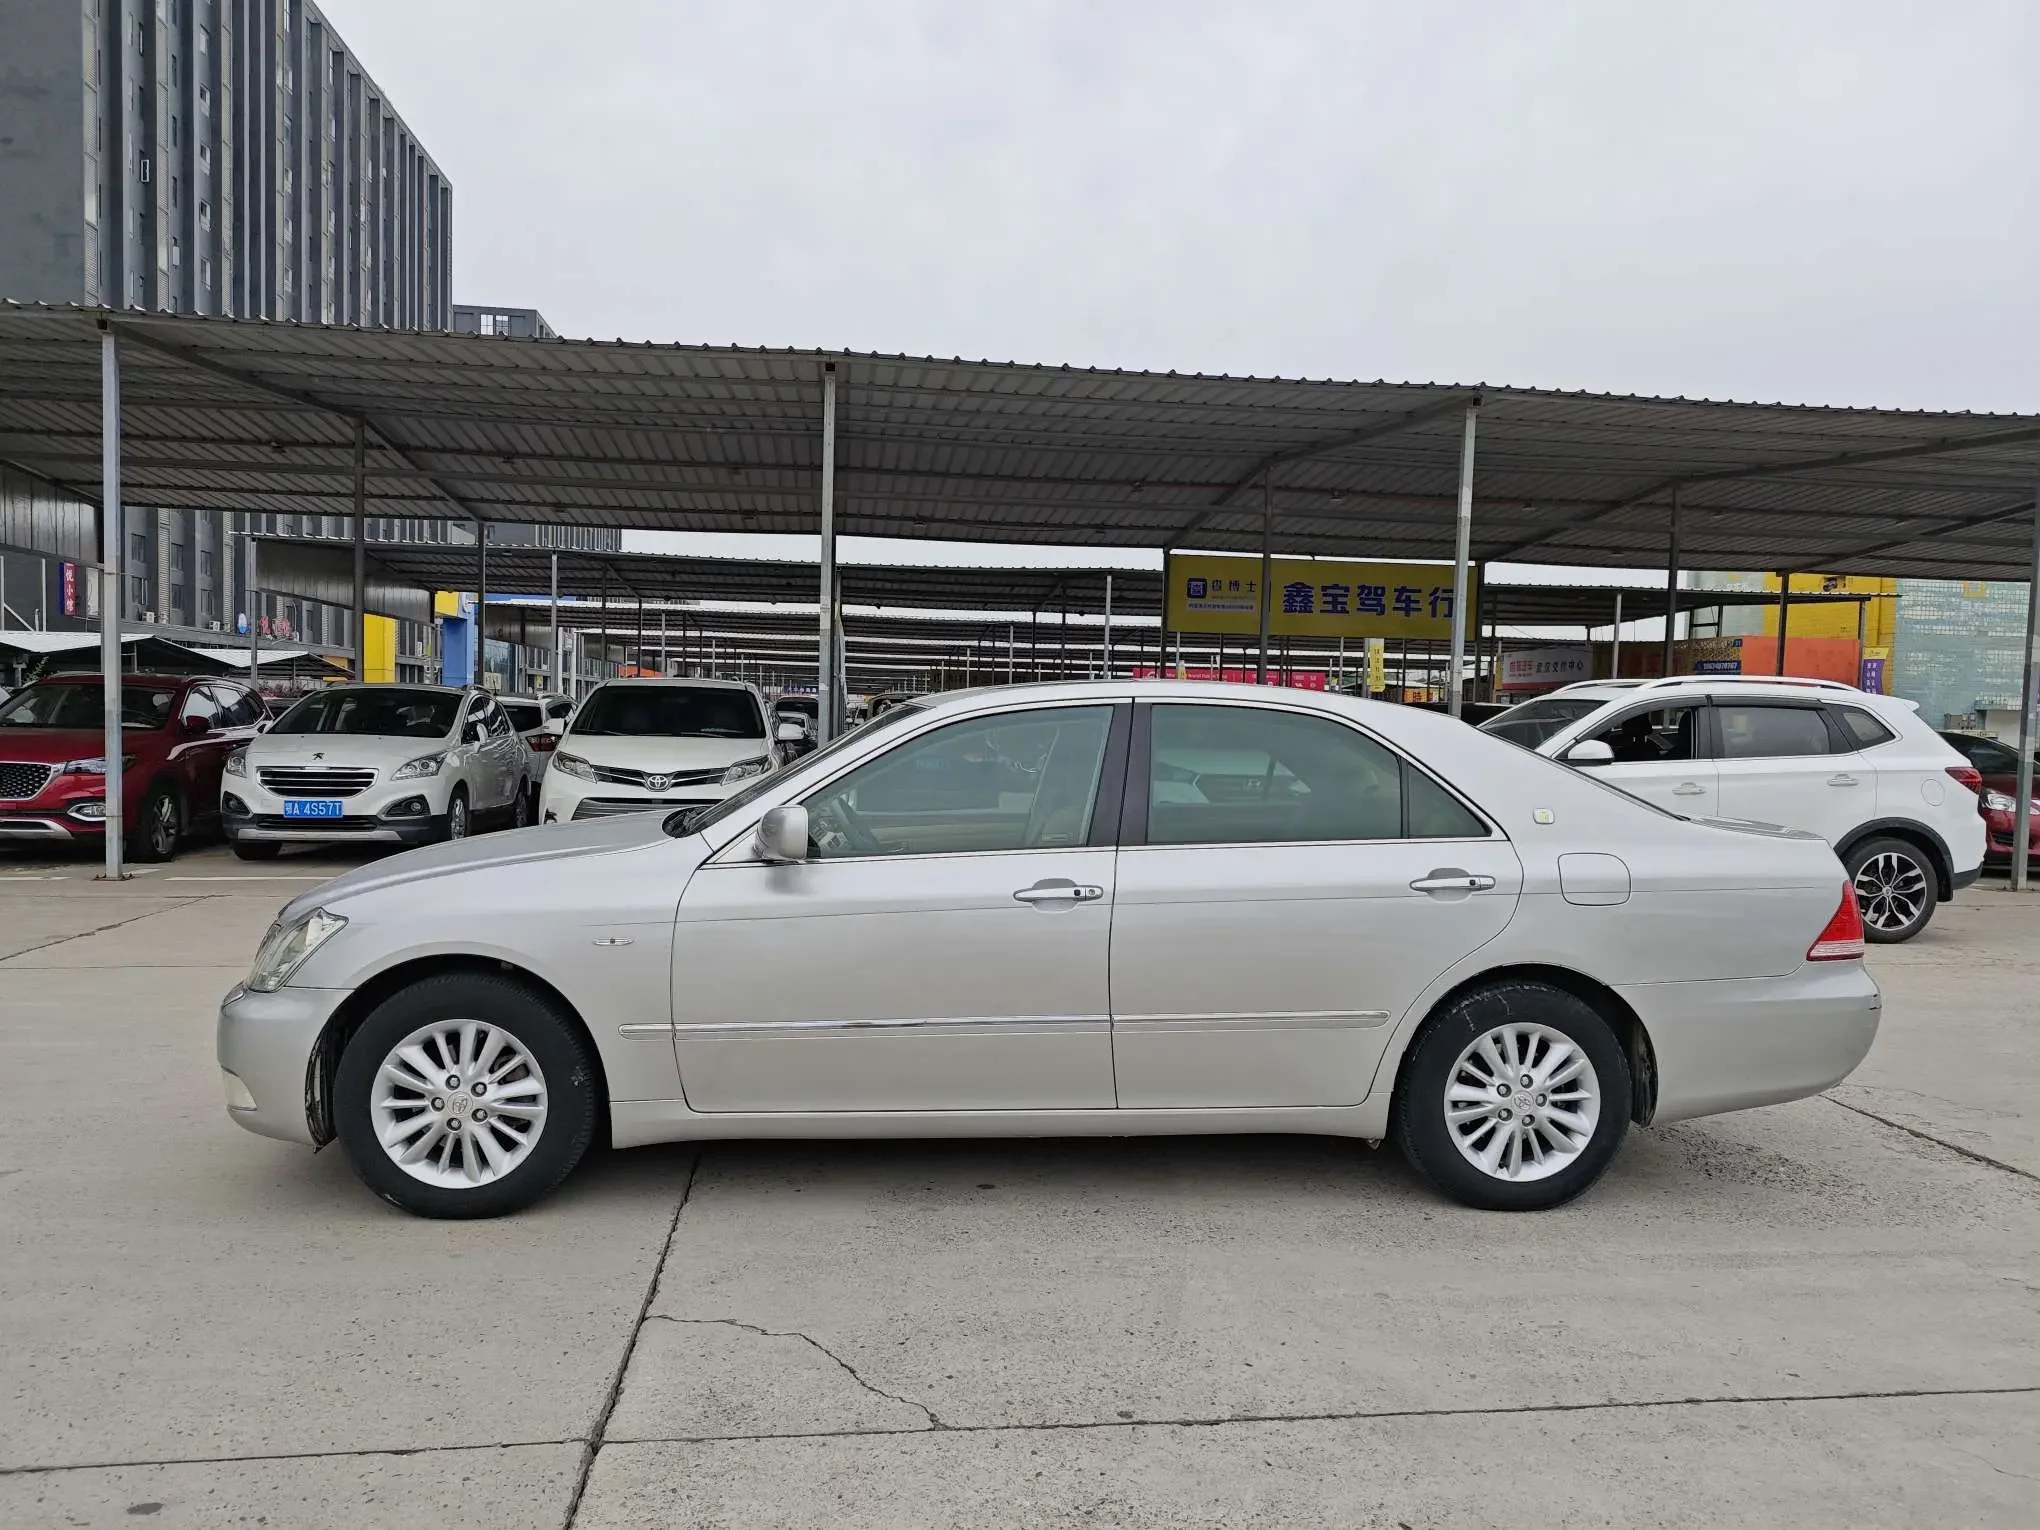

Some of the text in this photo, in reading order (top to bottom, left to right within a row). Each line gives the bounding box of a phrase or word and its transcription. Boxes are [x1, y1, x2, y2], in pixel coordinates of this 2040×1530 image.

[1282, 581, 1454, 618] 鑫宝驾车行
